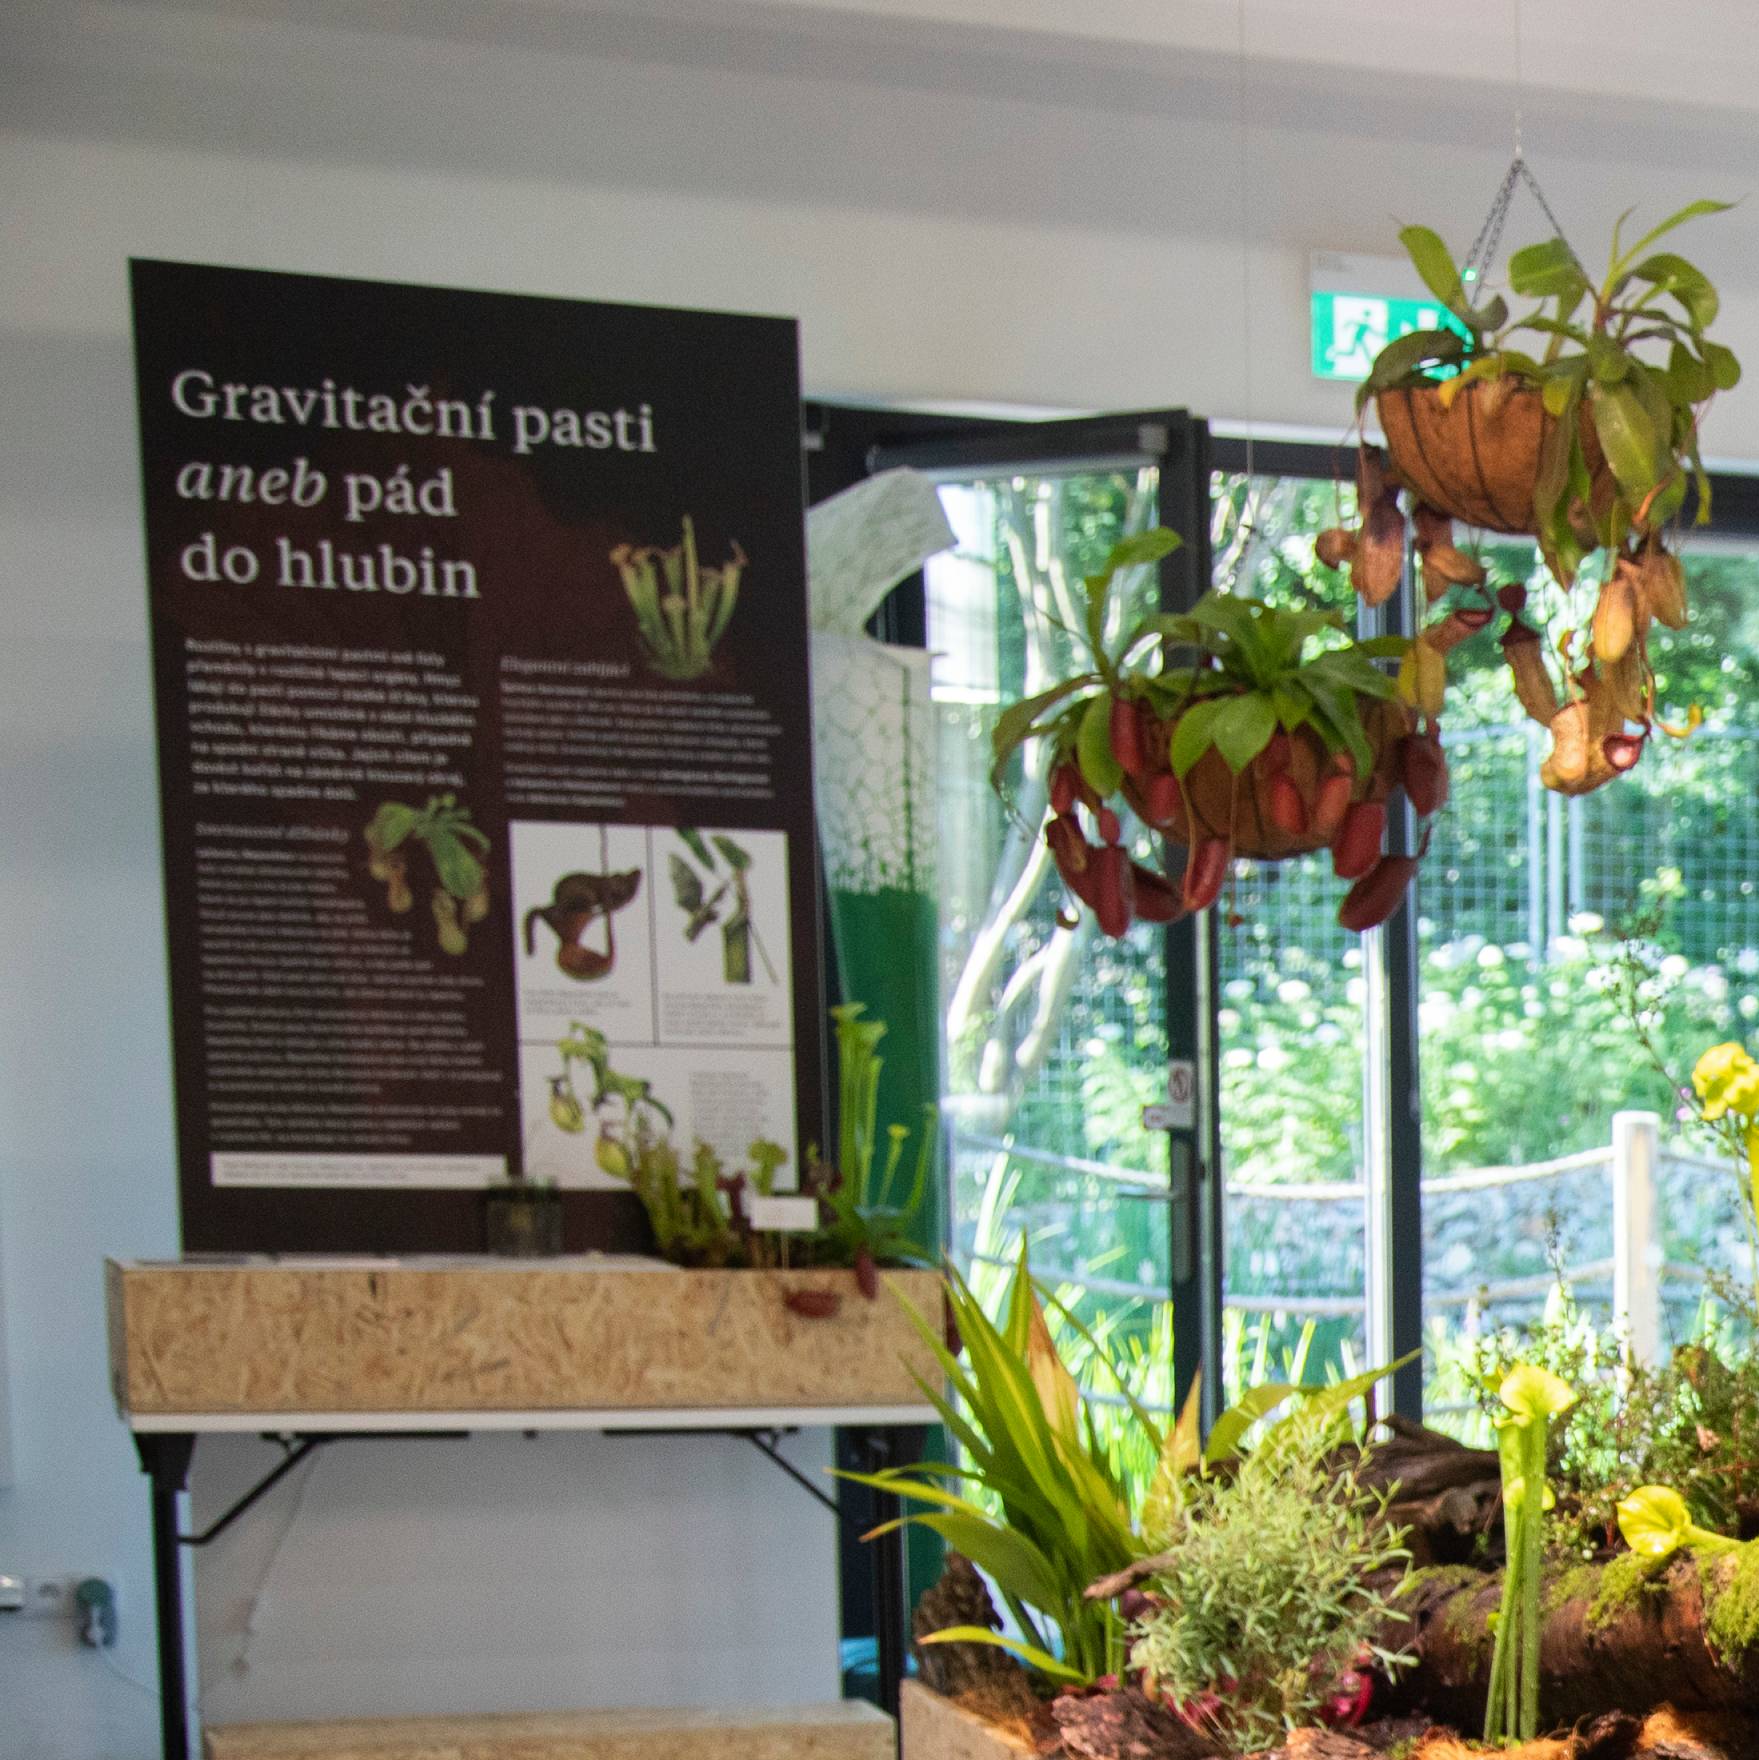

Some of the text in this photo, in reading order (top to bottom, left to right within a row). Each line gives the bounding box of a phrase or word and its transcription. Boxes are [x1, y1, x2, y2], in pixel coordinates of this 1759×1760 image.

[171, 370, 655, 453] Gravitační pasti
[176, 457, 457, 522] aneb pád
[181, 532, 482, 599] do hlubin
